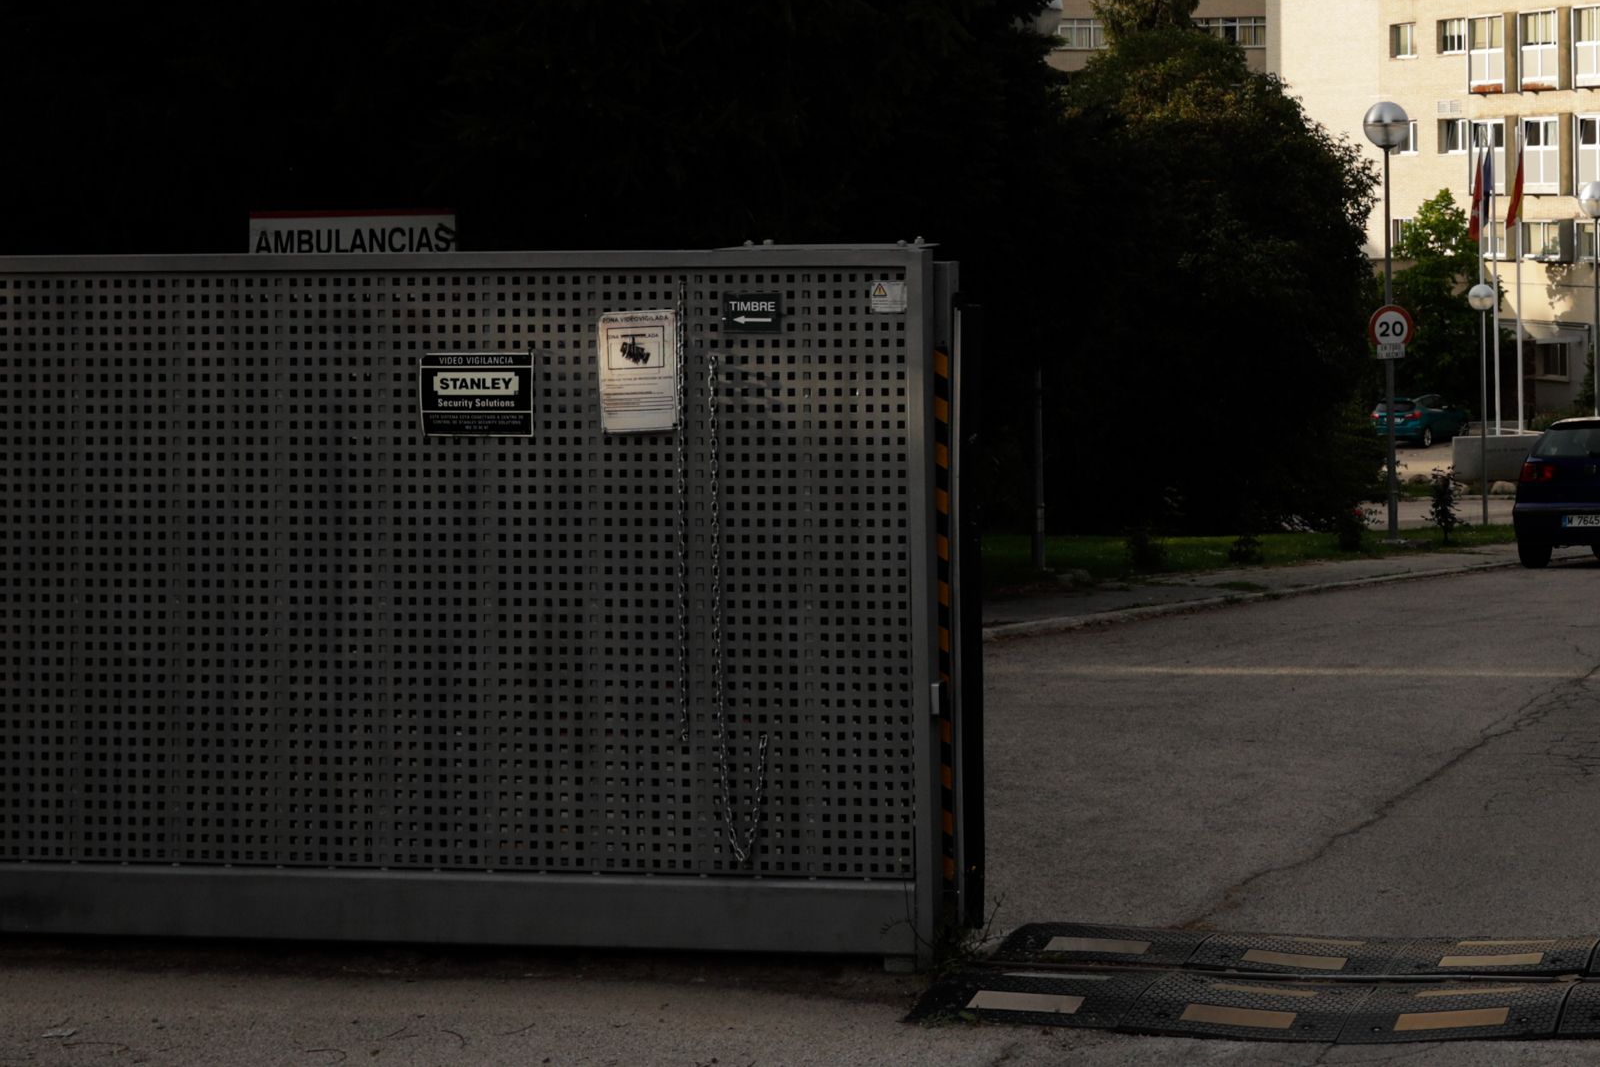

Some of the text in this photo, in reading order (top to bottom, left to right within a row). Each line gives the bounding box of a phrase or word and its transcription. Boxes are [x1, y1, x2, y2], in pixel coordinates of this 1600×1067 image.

[255, 226, 453, 253] AMBULANCIAS
[729, 301, 776, 312] TIMBRE
[1379, 321, 1404, 337] 20
[439, 356, 514, 365] VIDEO VIGILANCIA
[439, 378, 512, 390] STANLEY
[438, 398, 515, 409] Security Solutions
[1578, 515, 1600, 525] 7645
